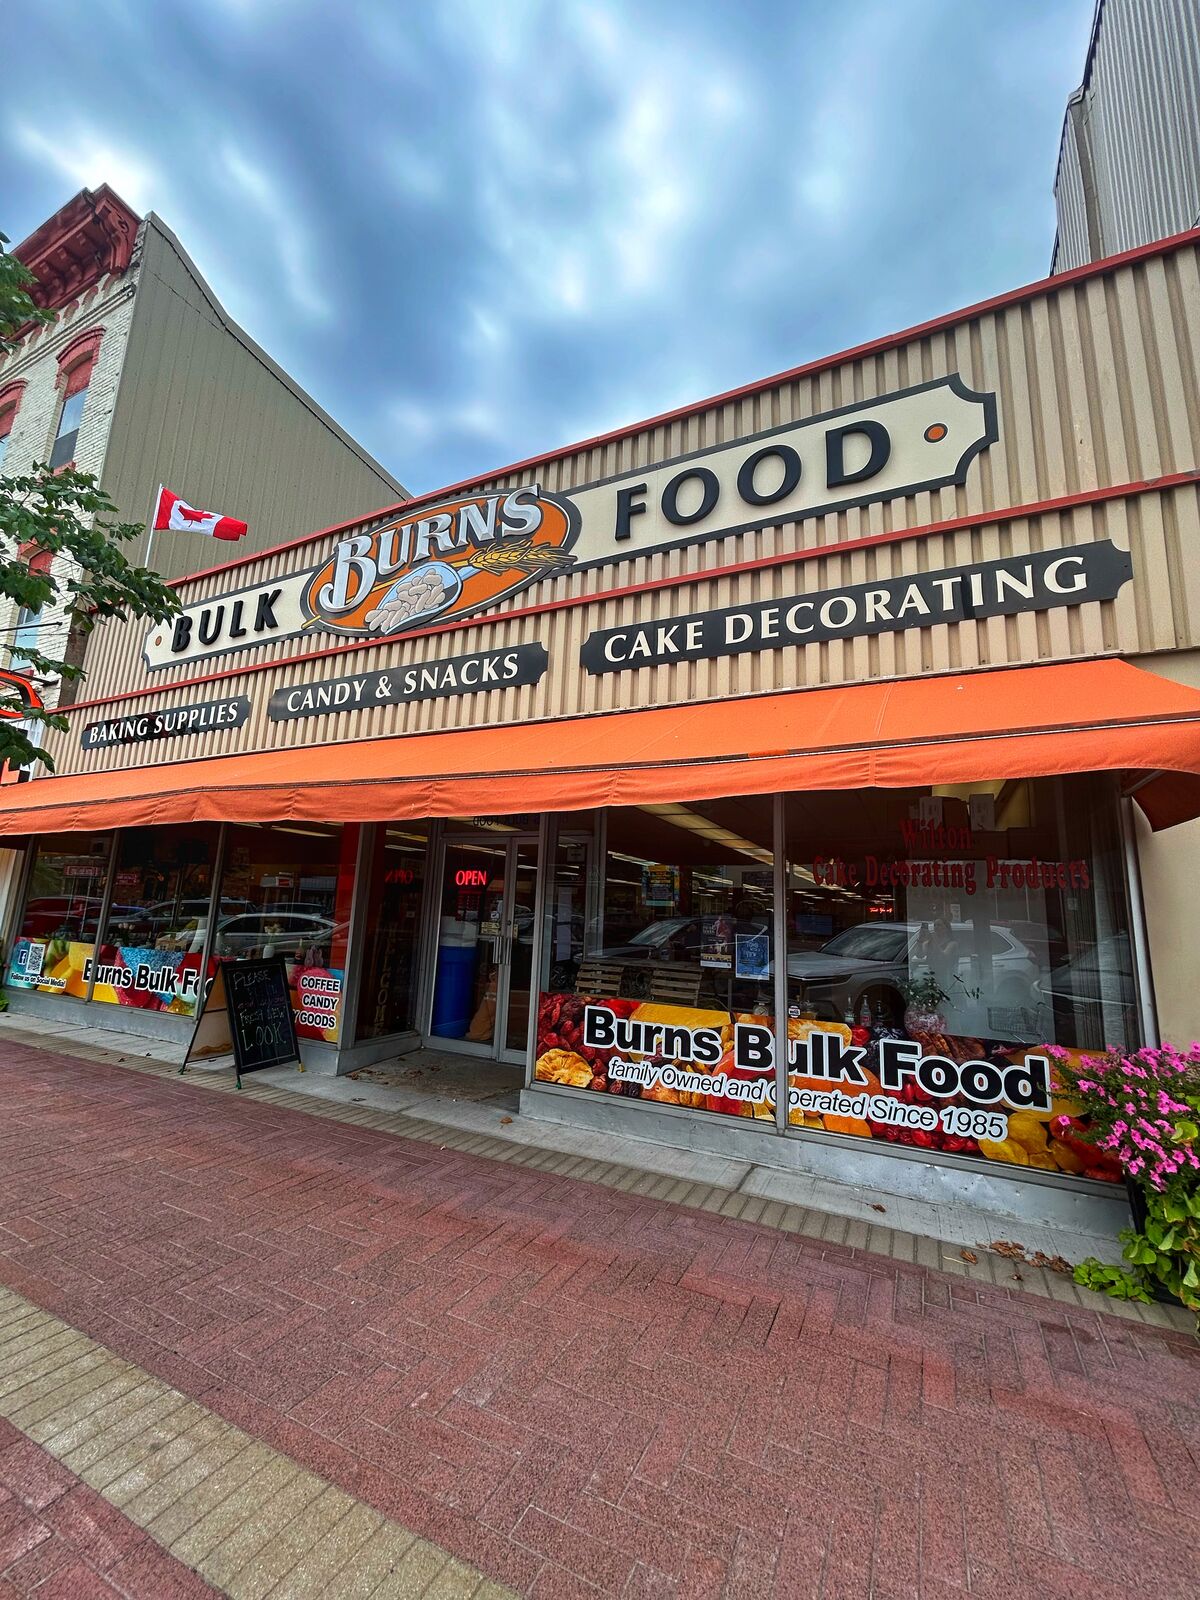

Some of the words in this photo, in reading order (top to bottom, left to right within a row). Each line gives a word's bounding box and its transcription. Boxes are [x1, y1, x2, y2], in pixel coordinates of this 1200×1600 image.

[615, 420, 892, 541] FOOD
[320, 483, 542, 614] BURNS
[171, 588, 281, 653] BULK
[604, 620, 703, 663] CAKE
[725, 556, 1088, 644] DECORATING
[287, 679, 366, 713] CANDY
[375, 676, 392, 698] &
[404, 653, 519, 695] SNACKS
[89, 717, 147, 743] BAKING
[154, 702, 239, 734] SUPPLIES
[901, 818, 973, 850] Wilton
[455, 869, 487, 886] OPEN
[812, 855, 858, 887] Cake
[865, 855, 976, 895] Decorating
[986, 855, 1090, 890] Products
[136, 965, 178, 993] Bulk
[301, 976, 340, 992] COFFEE
[300, 1011, 335, 1028] GOODS
[303, 994, 338, 1010] CANDY
[242, 1023, 287, 1051] LOOK
[585, 1008, 721, 1063] Burns
[737, 1026, 866, 1082] Bulk
[882, 1042, 1050, 1109] Food
[611, 1060, 656, 1086] family
[662, 1068, 724, 1094] Owned
[727, 1080, 764, 1100] and
[871, 1099, 934, 1128] Since
[943, 1108, 1004, 1139] 1985
